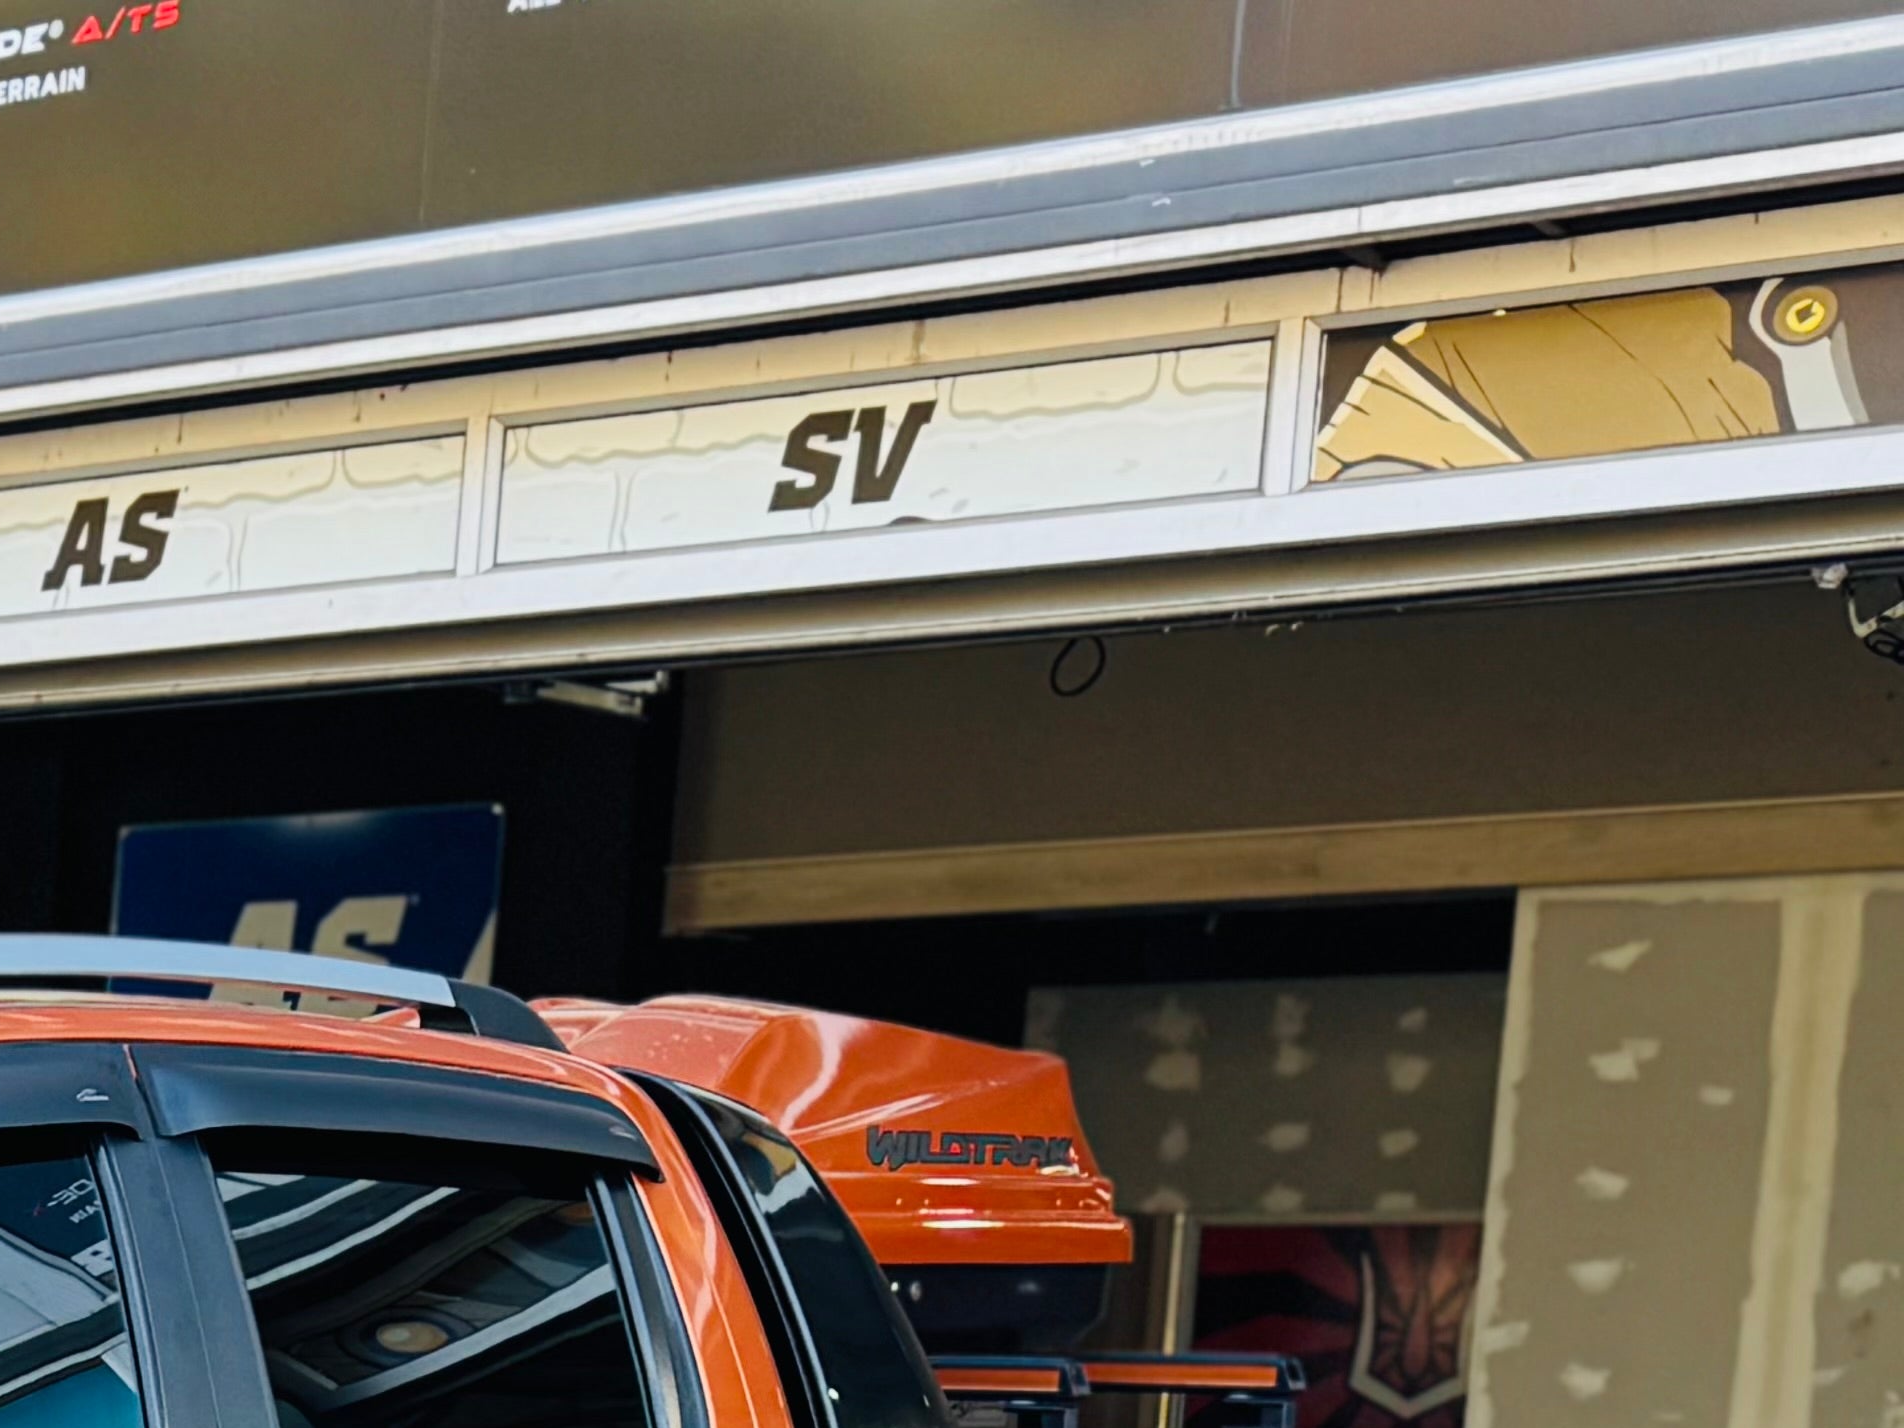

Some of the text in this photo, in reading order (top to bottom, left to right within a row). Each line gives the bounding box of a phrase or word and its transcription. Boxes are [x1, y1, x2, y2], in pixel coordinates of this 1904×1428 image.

[768, 399, 937, 513] SV
[42, 488, 180, 592] AS
[866, 1124, 1073, 1170] WILDTRAK
